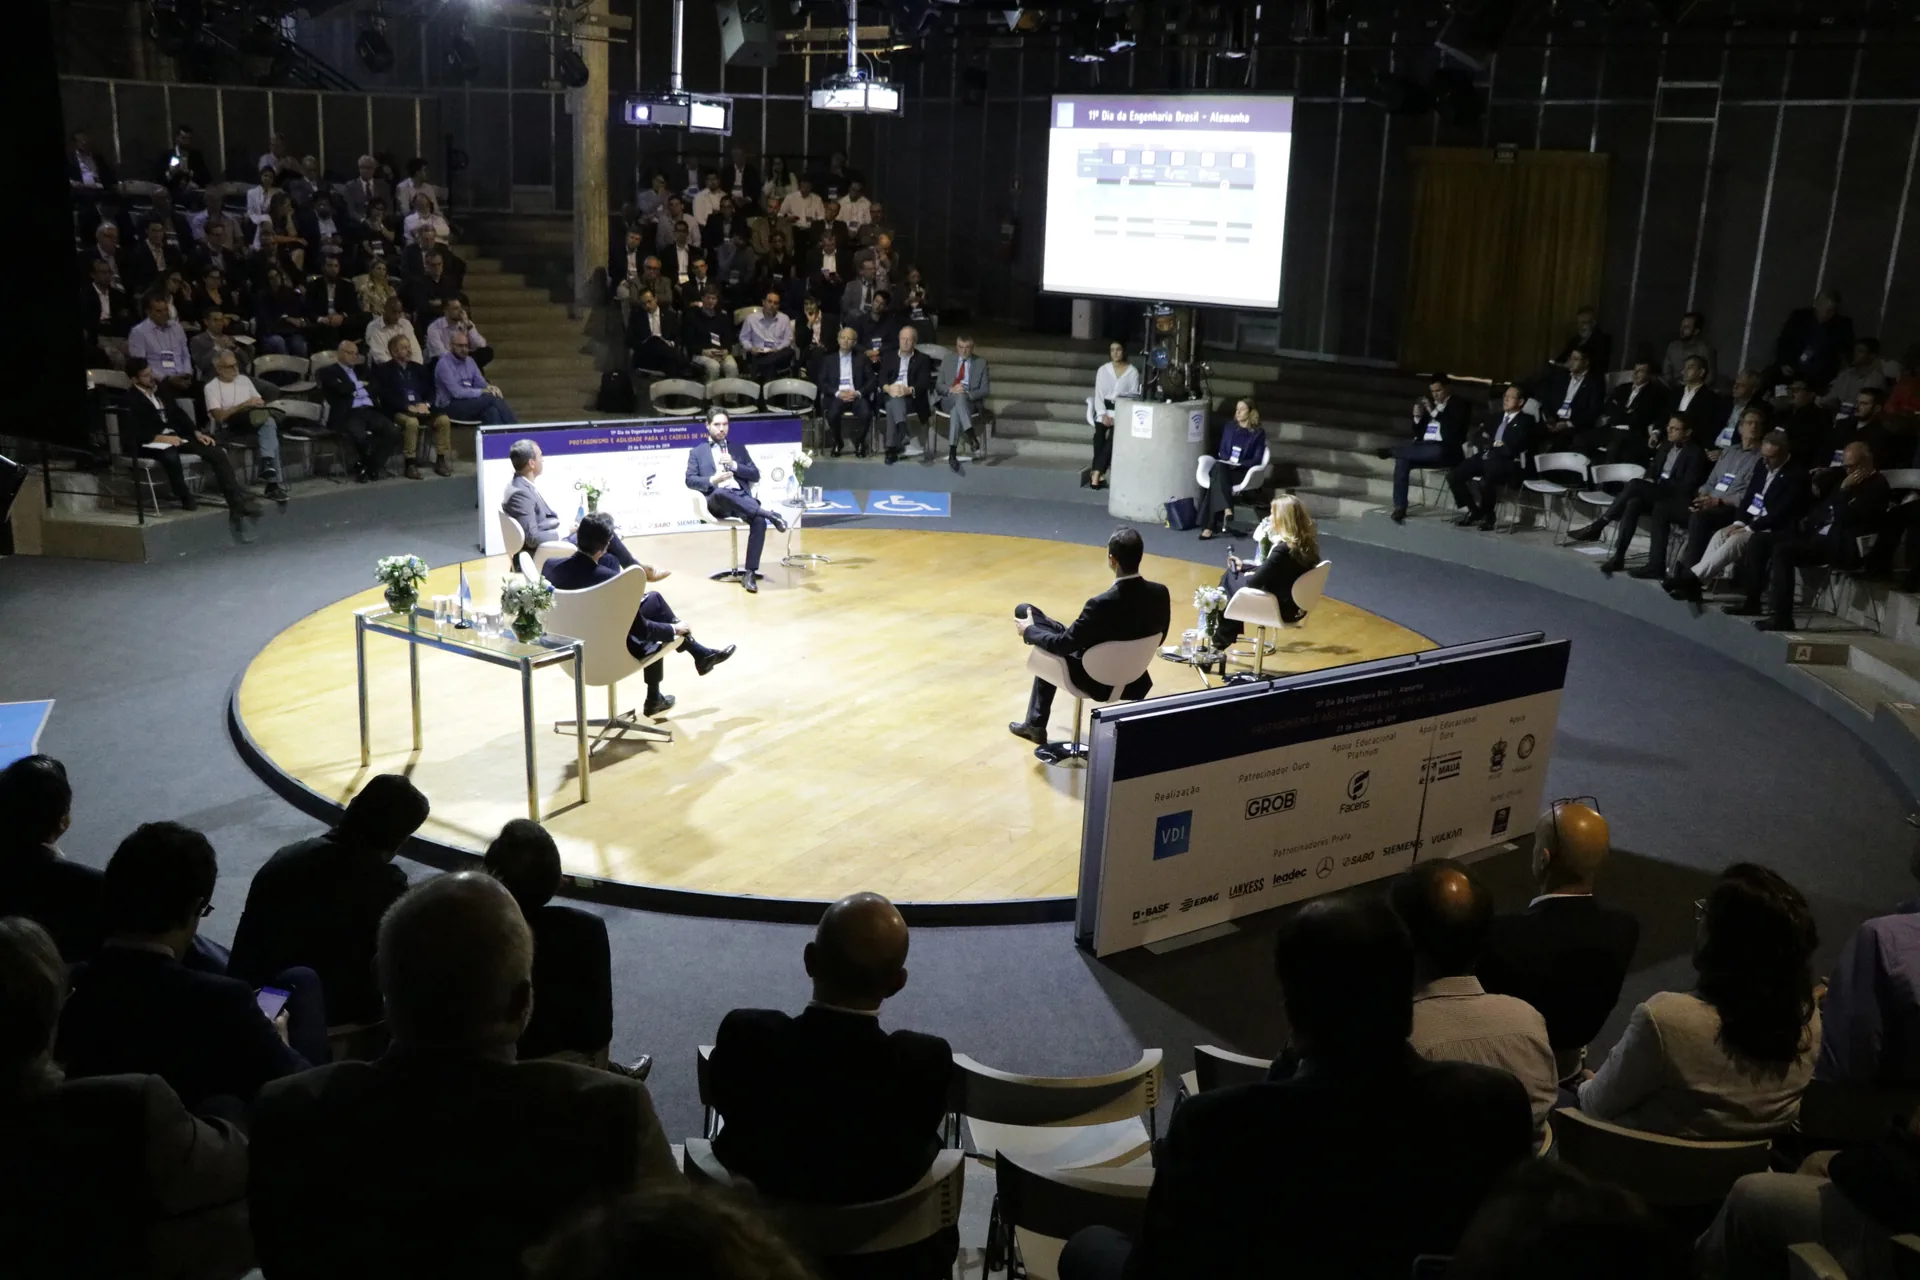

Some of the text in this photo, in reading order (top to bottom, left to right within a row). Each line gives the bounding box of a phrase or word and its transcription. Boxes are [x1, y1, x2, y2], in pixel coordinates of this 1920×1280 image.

[1102, 110, 1114, 121] Dia
[1117, 110, 1126, 121] da
[1129, 110, 1172, 124] Engenharia
[1176, 111, 1199, 122] Brasil
[1210, 112, 1249, 123] Alemanha
[676, 519, 701, 527] SIEMEN
[1799, 648, 1808, 658] A
[1419, 715, 1478, 735] Apoio Educacional
[1332, 732, 1397, 753] Apoio Educacional
[1347, 748, 1379, 760] Platinum
[1238, 761, 1310, 783] Patrocinador Ouro
[1154, 785, 1200, 802] Realização
[1247, 792, 1295, 816] GROB
[1339, 800, 1371, 814] Facens
[1161, 825, 1186, 844] VDI
[1431, 828, 1463, 845] VULKAN
[1273, 833, 1351, 858] Patrocinadores Prata
[1382, 839, 1424, 856] SIEMENS
[1273, 868, 1307, 885] leadec
[1228, 878, 1265, 898] LANXESS
[1193, 892, 1220, 907] EDAG
[1145, 902, 1170, 916] BASF
